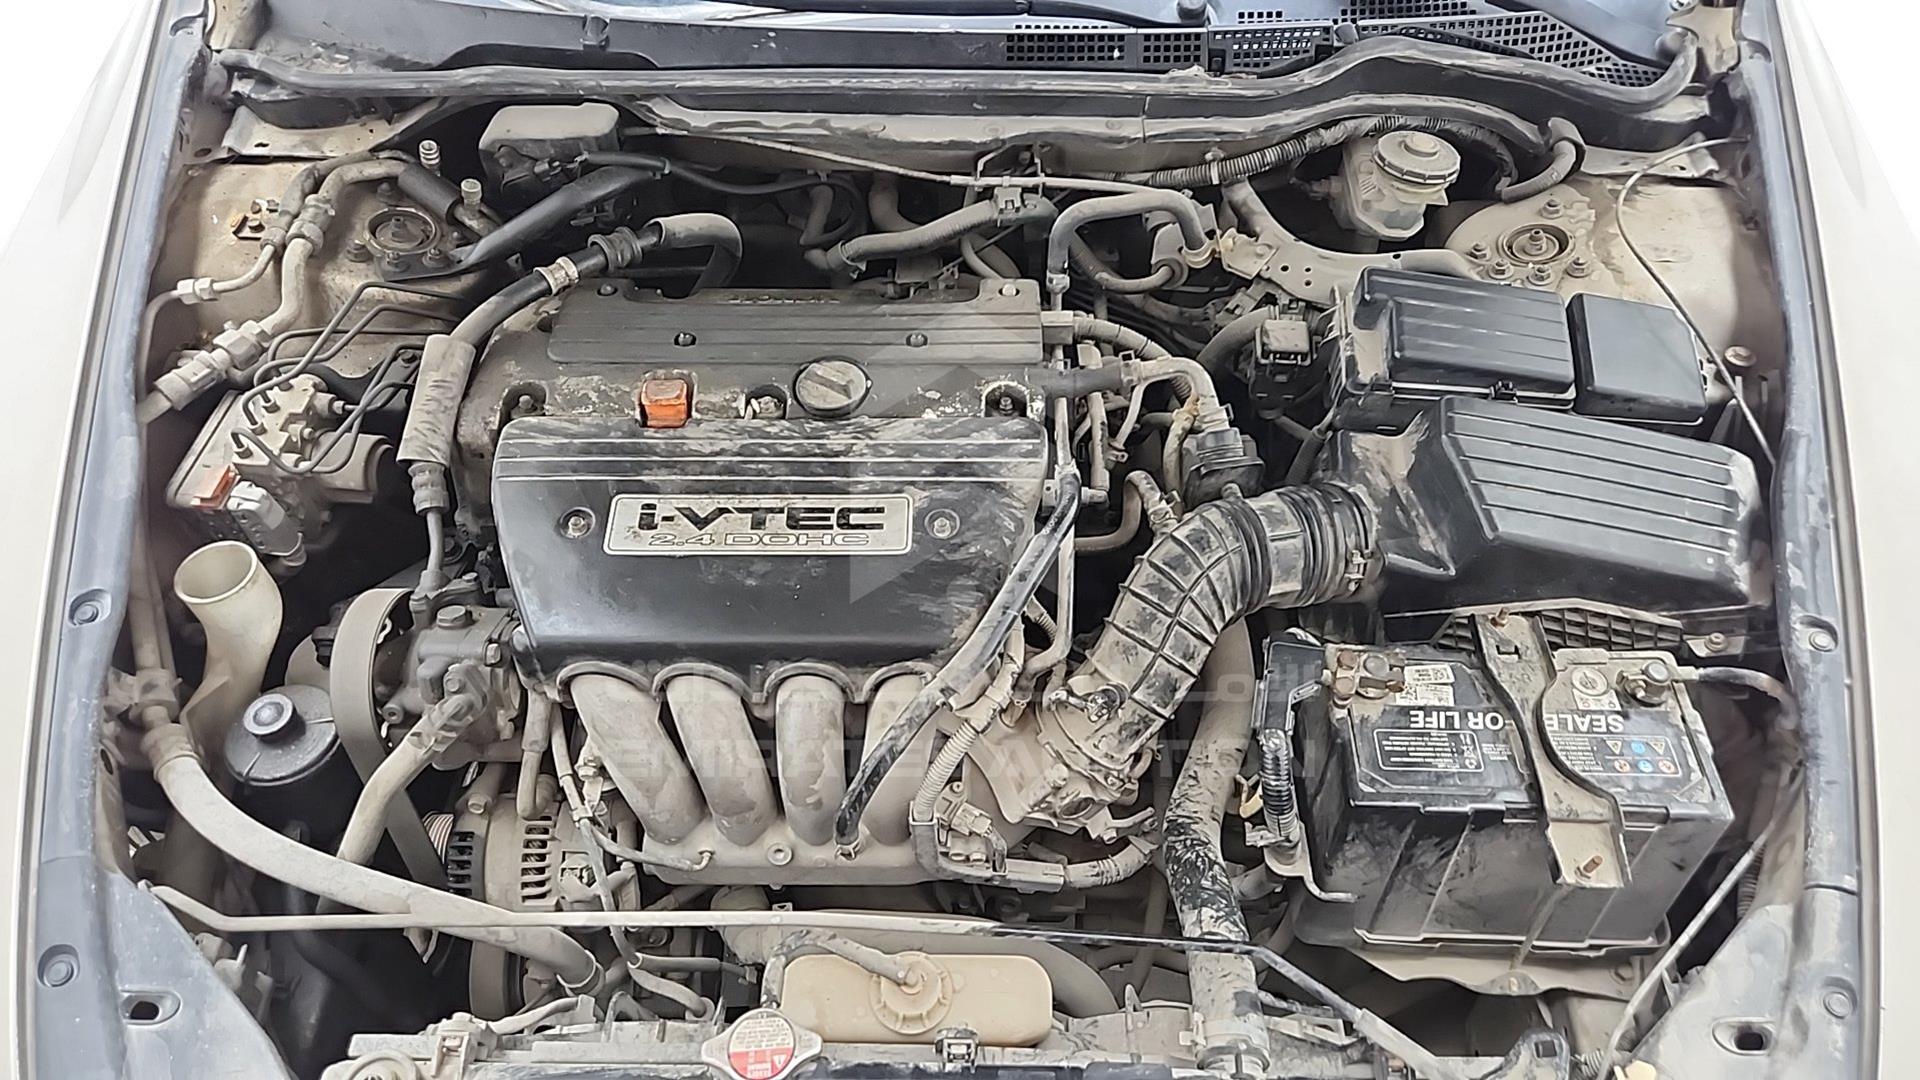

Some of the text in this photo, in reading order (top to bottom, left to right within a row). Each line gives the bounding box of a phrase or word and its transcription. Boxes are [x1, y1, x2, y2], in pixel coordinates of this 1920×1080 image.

[637, 503, 886, 531] i-VTEC
[649, 533, 870, 546] 2.4 DOHC
[1409, 710, 1461, 730] LIFE
[1546, 712, 1625, 733] SEALE
